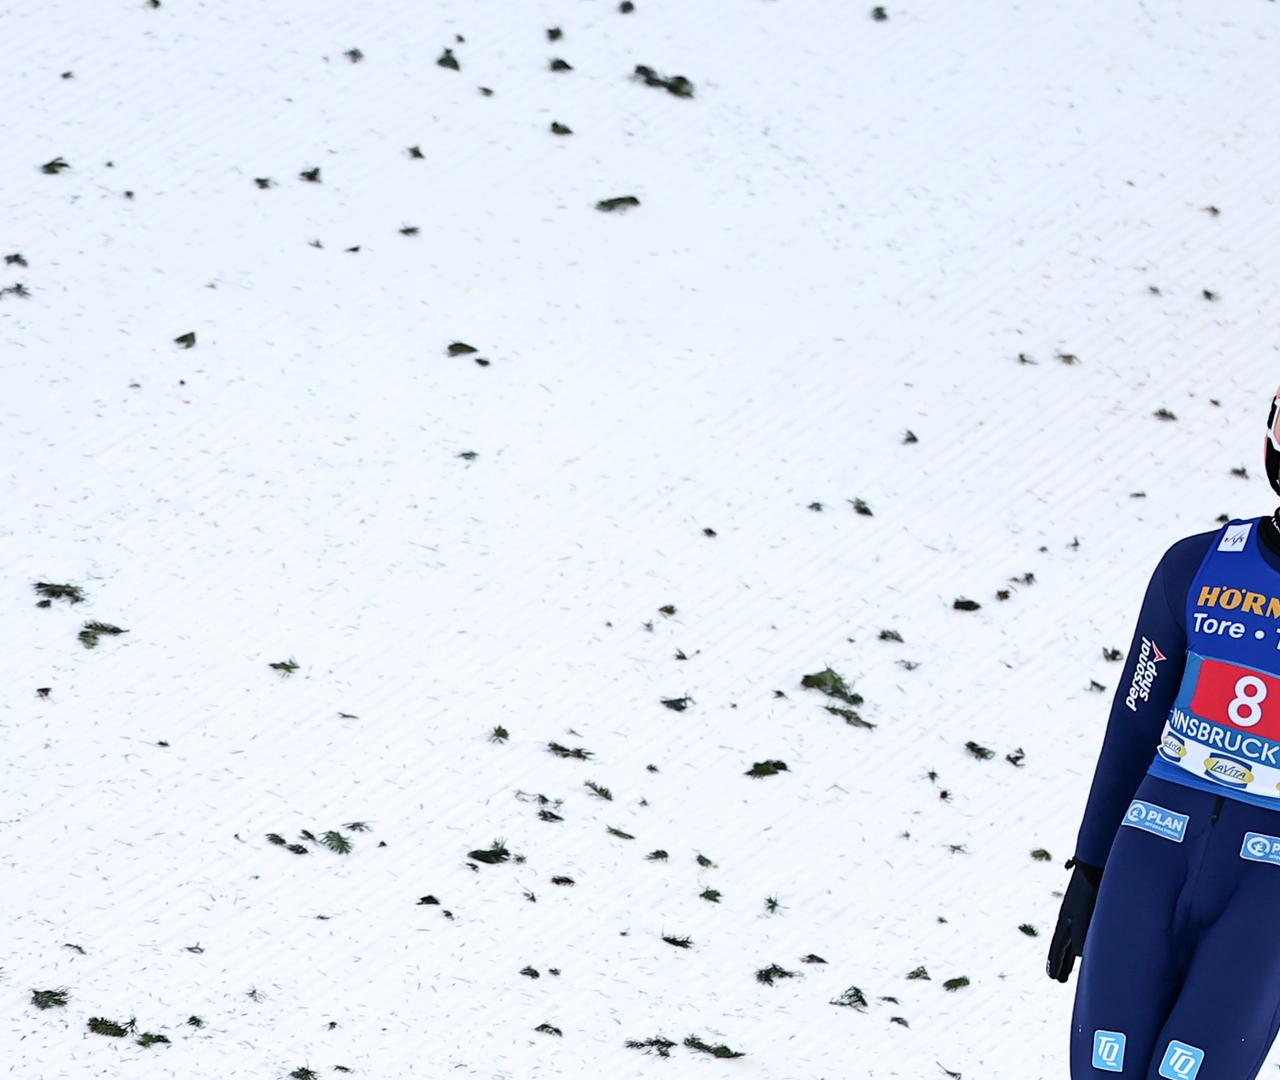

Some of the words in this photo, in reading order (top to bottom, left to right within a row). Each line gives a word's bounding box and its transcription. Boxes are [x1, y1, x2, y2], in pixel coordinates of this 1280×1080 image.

[1193, 612, 1246, 638] Tore
[1125, 636, 1151, 712] personal
[1139, 660, 1158, 702] shop
[1227, 675, 1268, 727] 8
[1170, 707, 1280, 765] NNSBRUCK
[1147, 809, 1183, 832] PLAN
[1098, 1036, 1120, 1066] TQ
[1169, 1046, 1196, 1080] TQ
